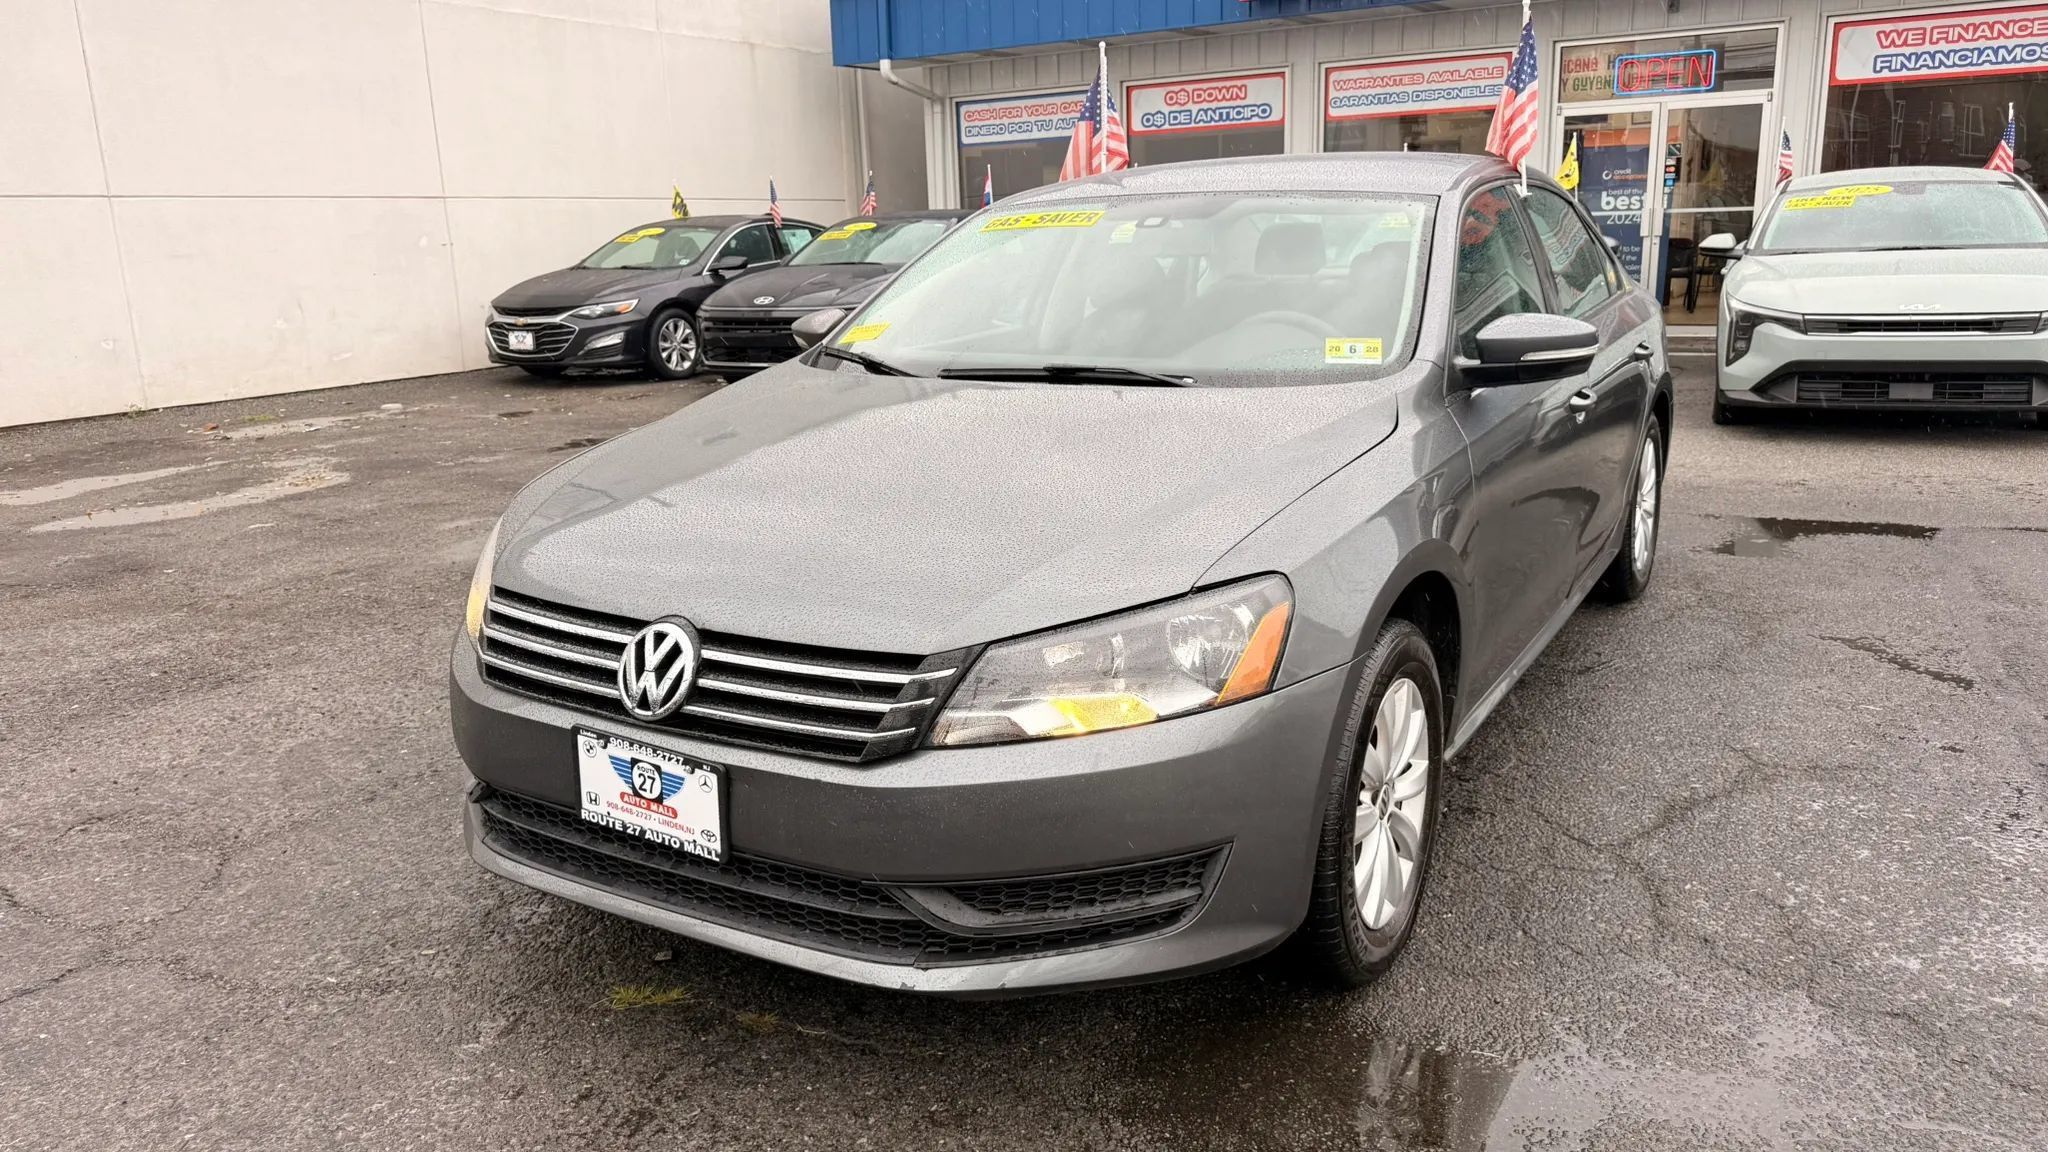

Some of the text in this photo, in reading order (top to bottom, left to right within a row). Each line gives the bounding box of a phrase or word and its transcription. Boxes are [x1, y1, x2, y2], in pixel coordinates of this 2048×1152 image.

[1876, 17, 2048, 49] WE FINANCE
[1333, 66, 1505, 92] WARRANTIES AVAILABLE
[1572, 74, 1614, 92] GUYAN
[1617, 54, 1714, 92] OPEN
[1193, 84, 1247, 104] DOWN
[1330, 84, 1503, 108] GARANTIAS DISPONIBLES
[964, 109, 998, 122] CASH
[999, 107, 1022, 119] FOR
[1025, 104, 1058, 117] YOUR
[1168, 108, 1192, 127] DE
[1194, 103, 1272, 124] ANTICIPO
[965, 117, 1080, 138] DINERO POR TU AUT
[1606, 213, 1641, 225] 2024
[1349, 344, 1357, 354] 6
[609, 737, 684, 765] 908-648-2727
[637, 765, 656, 776] ROUTE
[637, 772, 657, 795] 27
[623, 795, 676, 818] AUTO MALL
[580, 809, 721, 862] ROUTE 27 AUTO MALL
